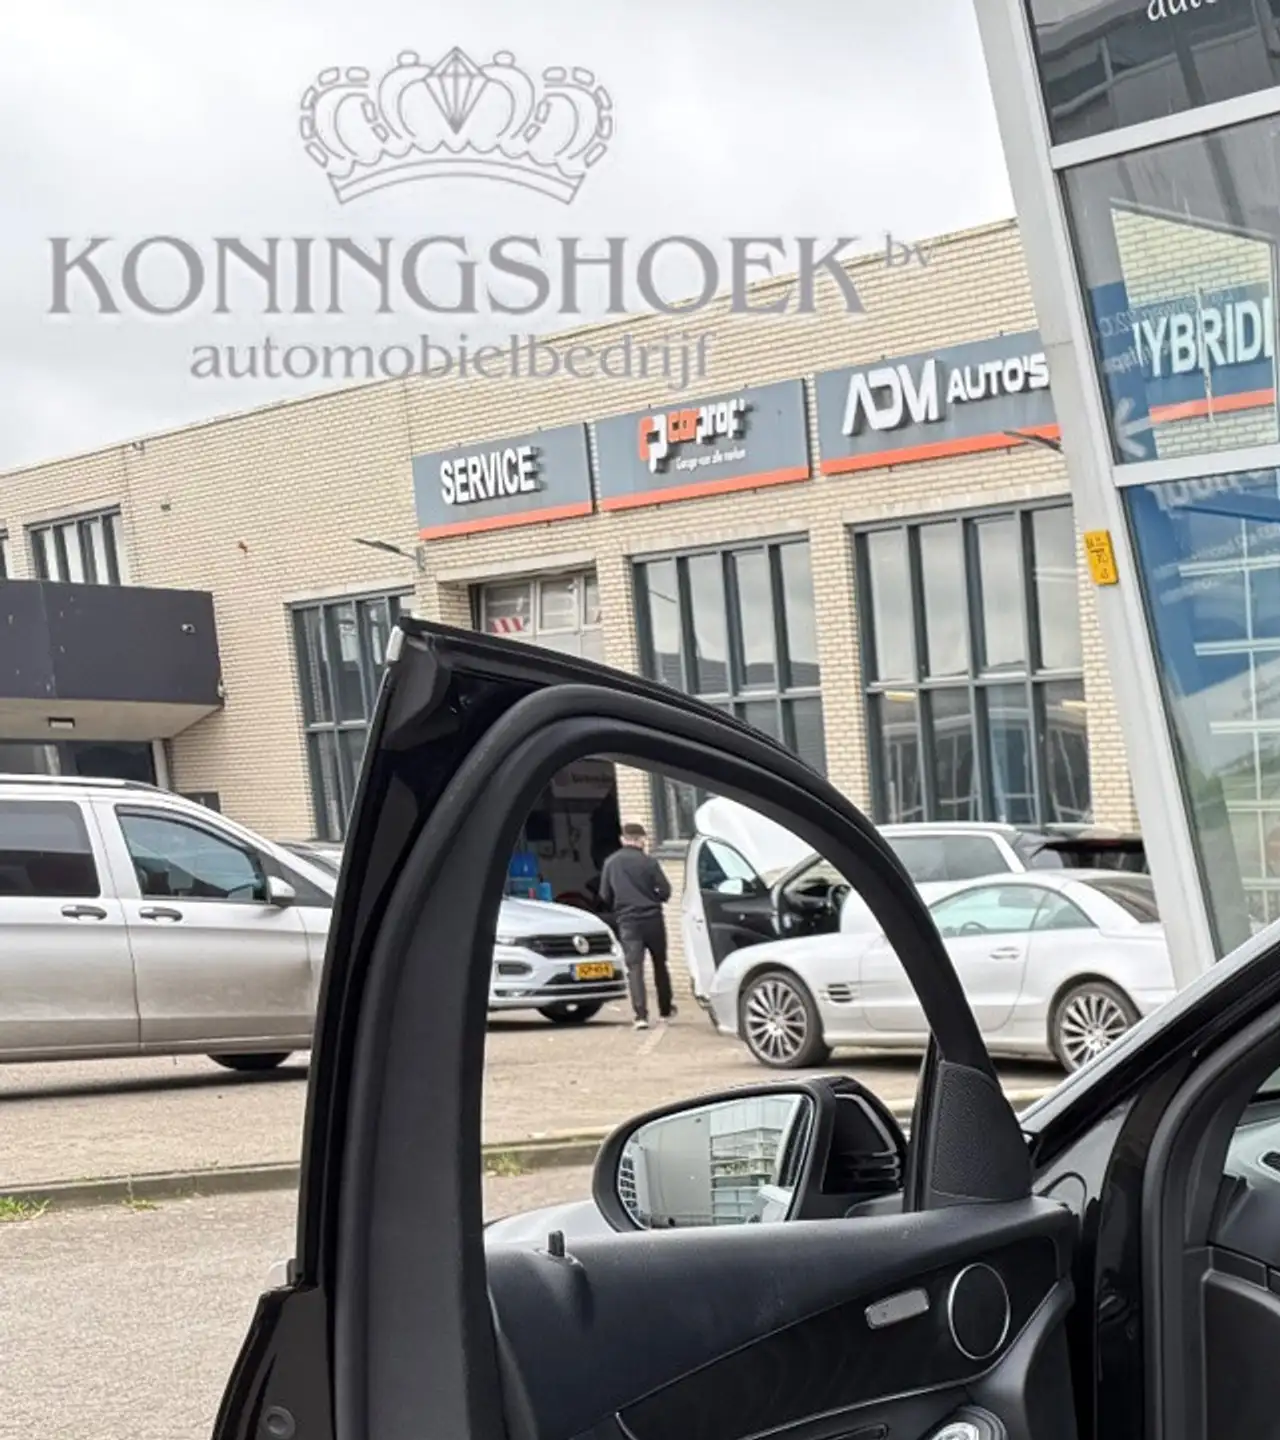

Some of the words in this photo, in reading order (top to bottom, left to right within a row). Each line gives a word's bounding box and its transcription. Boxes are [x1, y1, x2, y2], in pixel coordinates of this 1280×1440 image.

[842, 358, 940, 436] ADM
[946, 352, 1050, 404] AUTO'S
[440, 446, 537, 504] SERVICE
